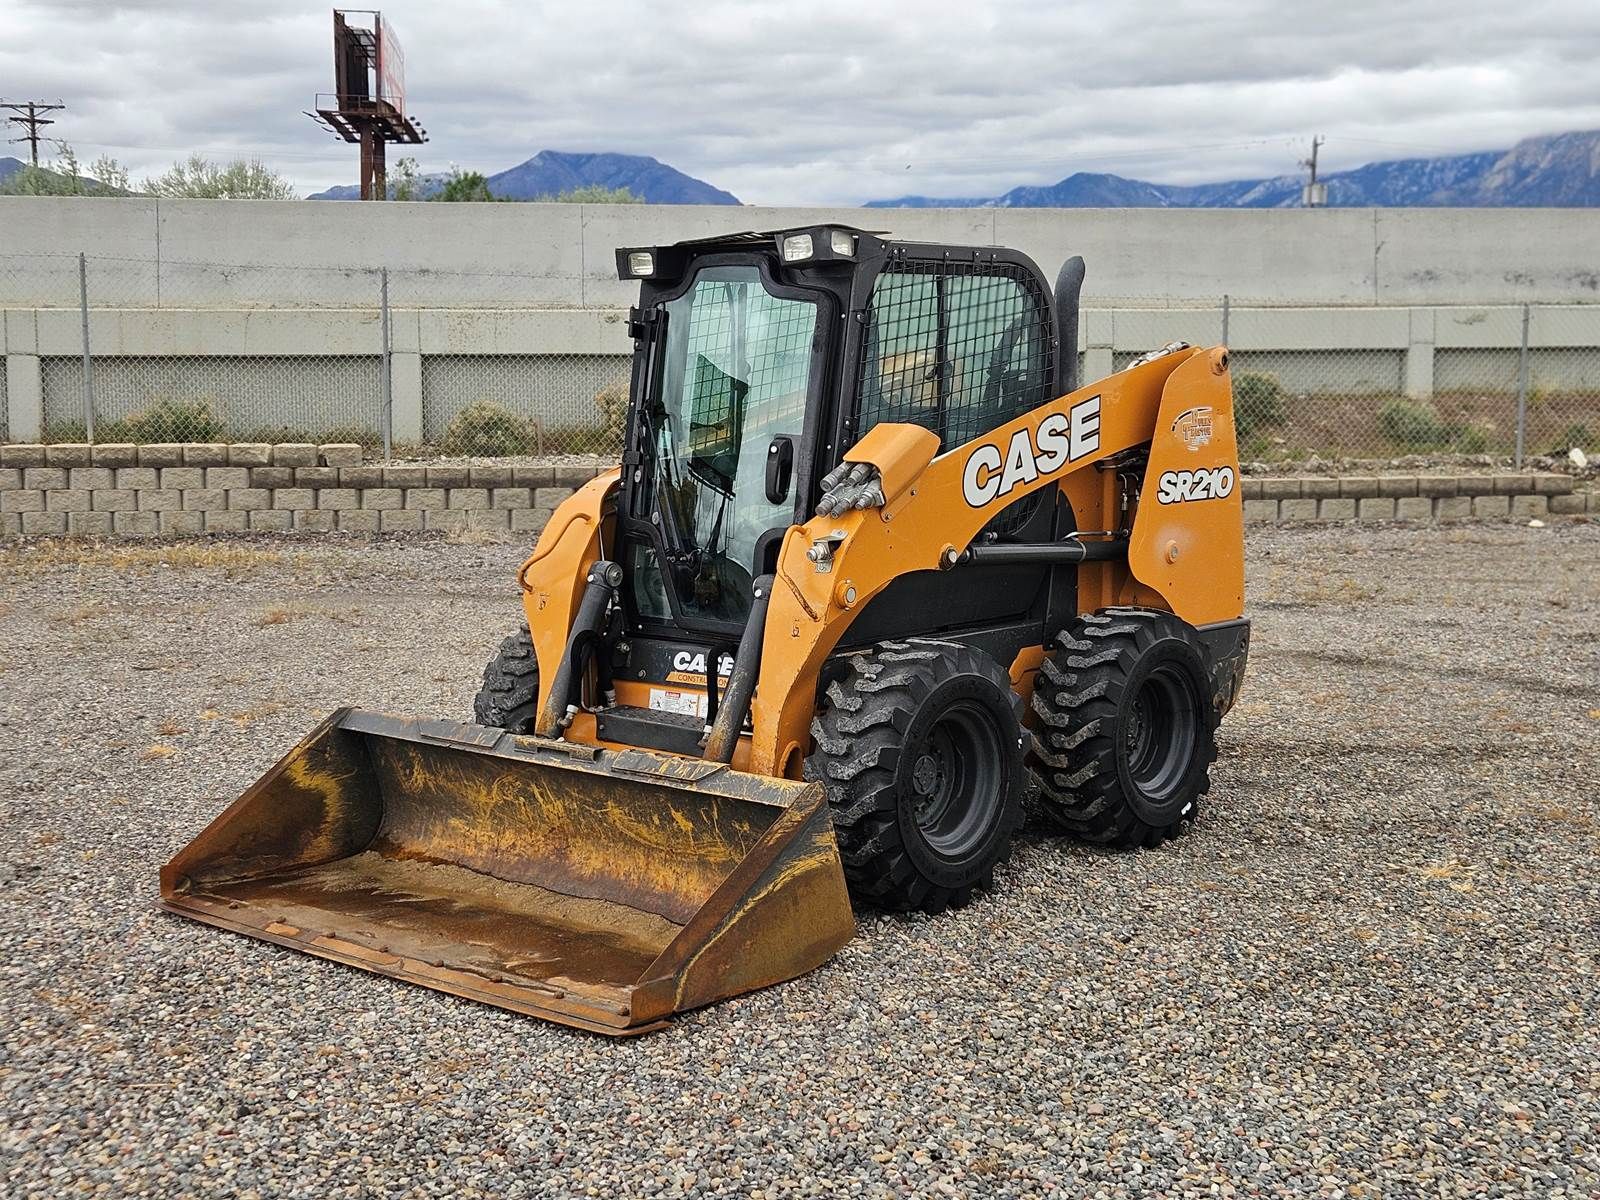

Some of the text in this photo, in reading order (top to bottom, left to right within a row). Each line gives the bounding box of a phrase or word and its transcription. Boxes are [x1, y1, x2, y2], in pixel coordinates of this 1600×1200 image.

[963, 394, 1101, 508] CASE
[1157, 466, 1234, 505] SR210
[677, 673, 727, 687] CONSTRON
